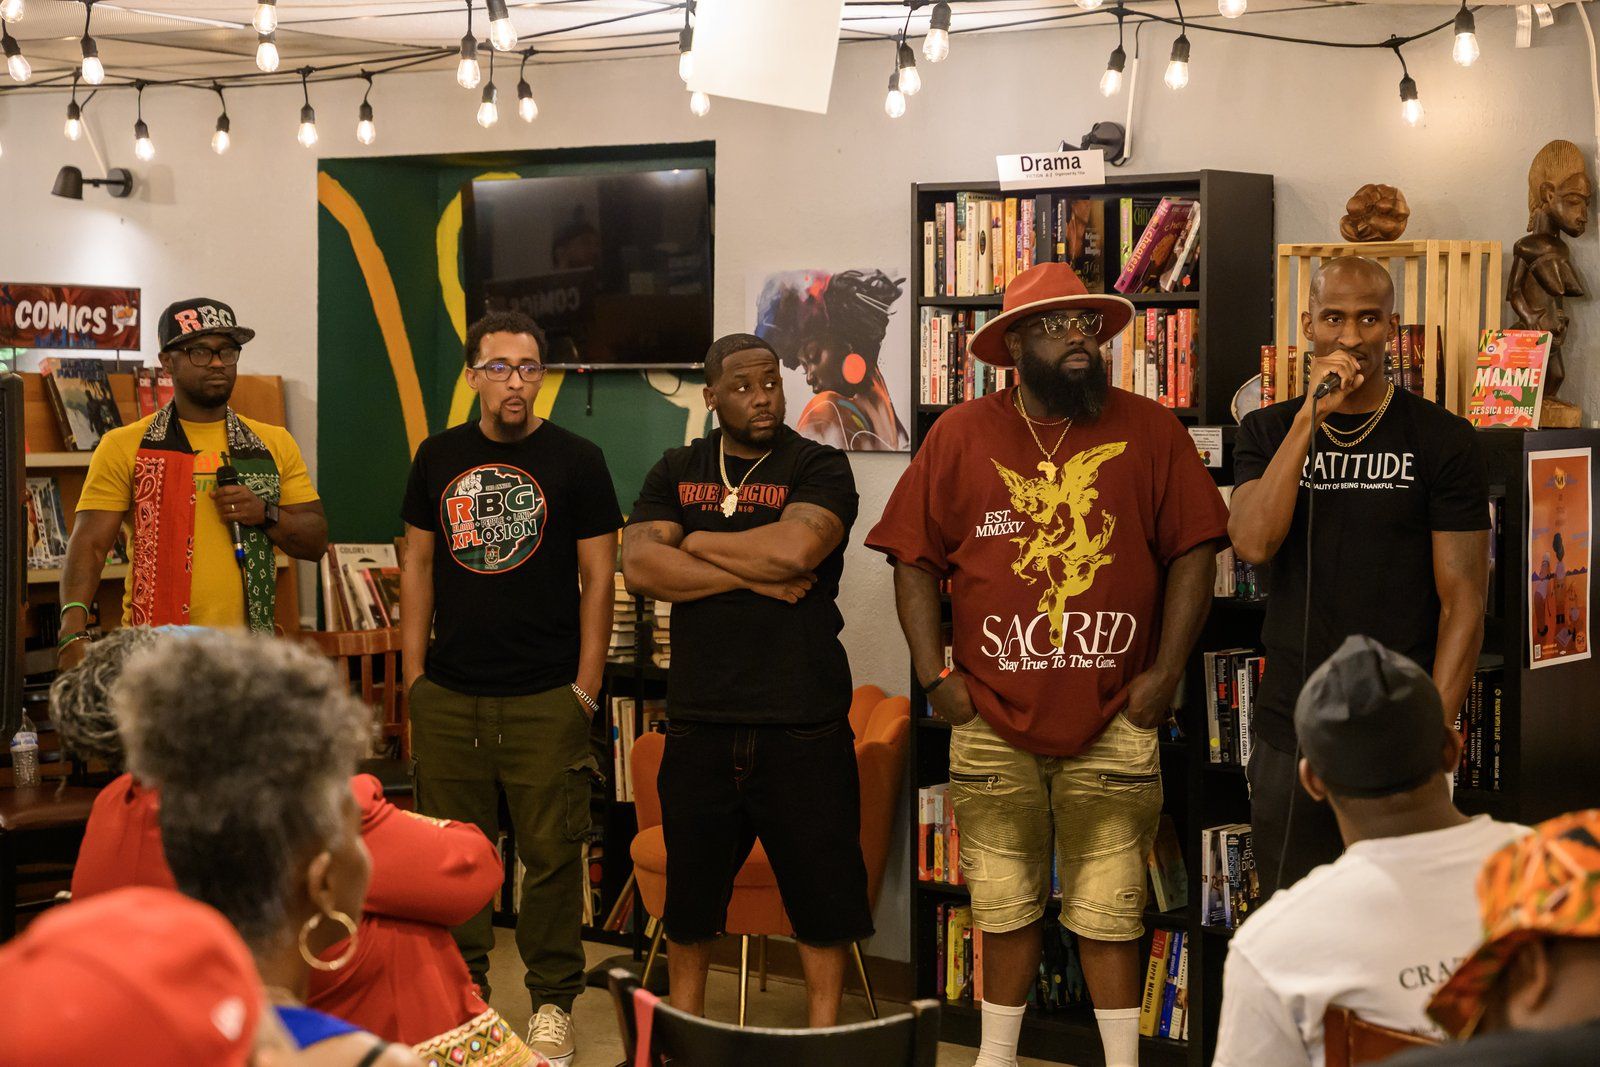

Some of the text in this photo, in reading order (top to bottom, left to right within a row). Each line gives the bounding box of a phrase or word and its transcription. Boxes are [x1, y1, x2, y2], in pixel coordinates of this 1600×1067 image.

[1020, 155, 1082, 172] Drama
[1126, 227, 1156, 273] cheaters
[14, 300, 108, 335] COMICS
[1392, 354, 1400, 369] Tell
[1402, 354, 1410, 369] Tell
[1475, 367, 1542, 387] MAAME
[1471, 405, 1534, 415] JESSICA GEORGE
[677, 482, 719, 507] TRUE
[1332, 482, 1340, 490] OF
[1340, 482, 1359, 490] BEING
[1360, 482, 1394, 490] THANKFUL
[445, 483, 536, 525] RBG
[983, 509, 1012, 525] EST.
[451, 518, 538, 551] XPLOSION
[975, 521, 1026, 538] MMXXV
[981, 611, 1136, 658] SACRED
[998, 655, 1019, 672] Stay
[1020, 655, 1048, 670] True
[1052, 655, 1066, 669] To
[1069, 655, 1093, 669] The
[1475, 738, 1483, 768] PRESIDENT
